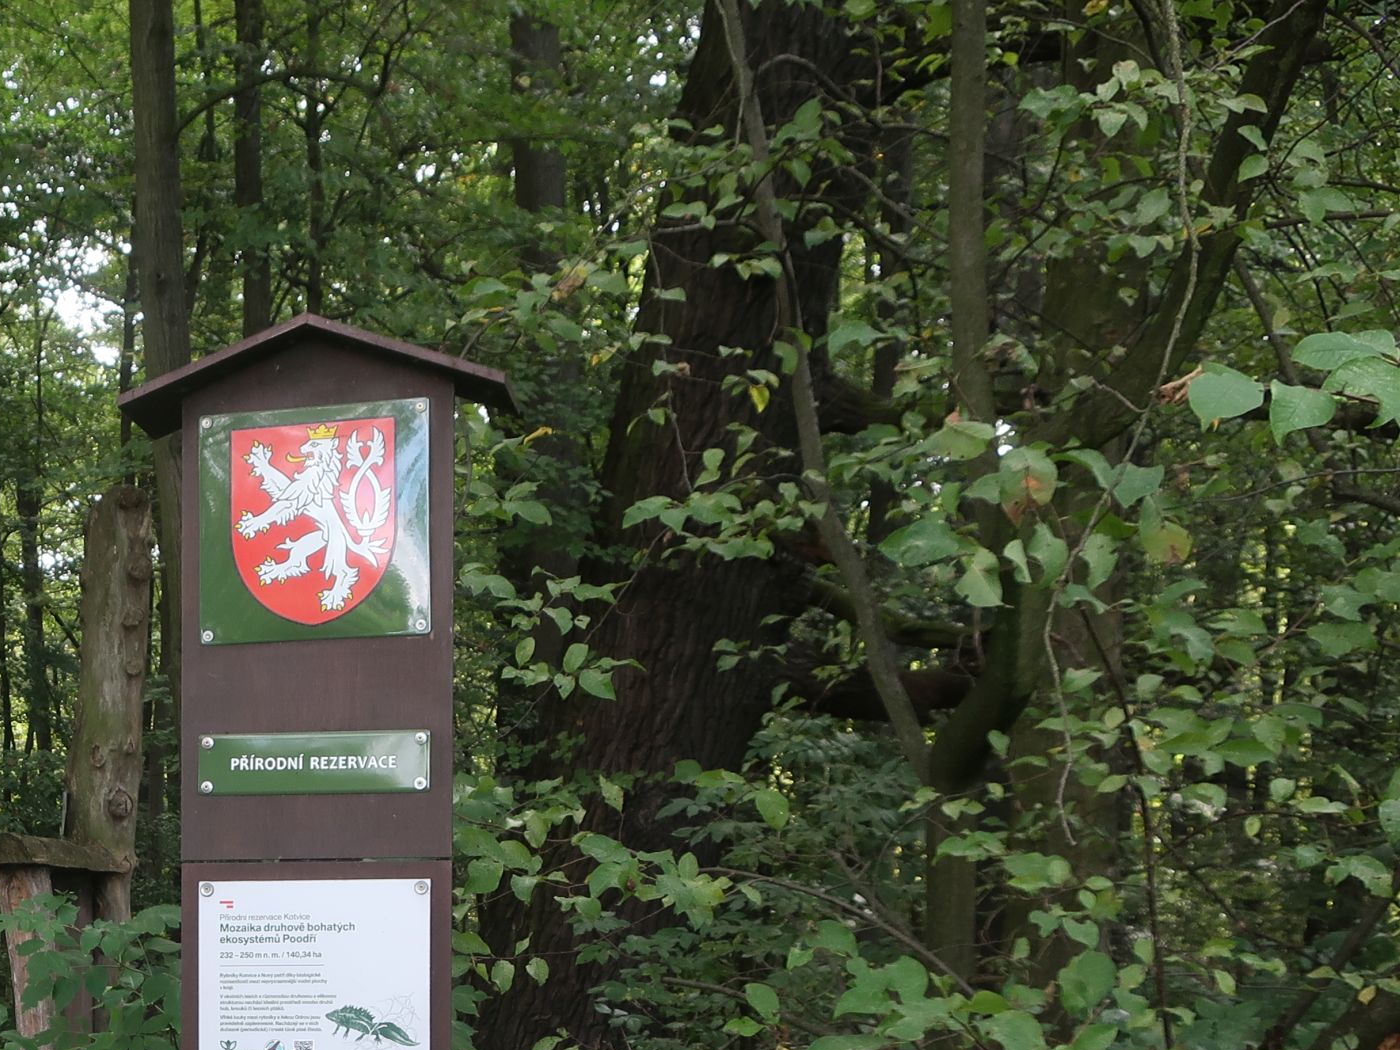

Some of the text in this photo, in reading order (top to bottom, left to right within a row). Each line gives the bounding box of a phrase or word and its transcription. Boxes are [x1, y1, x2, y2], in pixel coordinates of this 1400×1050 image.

[230, 753, 397, 770] PŘÍRODNÍ REZERVACE
[219, 922, 356, 933] Mozaika druhově bohatých
[219, 933, 317, 945] ekosystémů Poodří
[286, 951, 311, 959] 140,34
